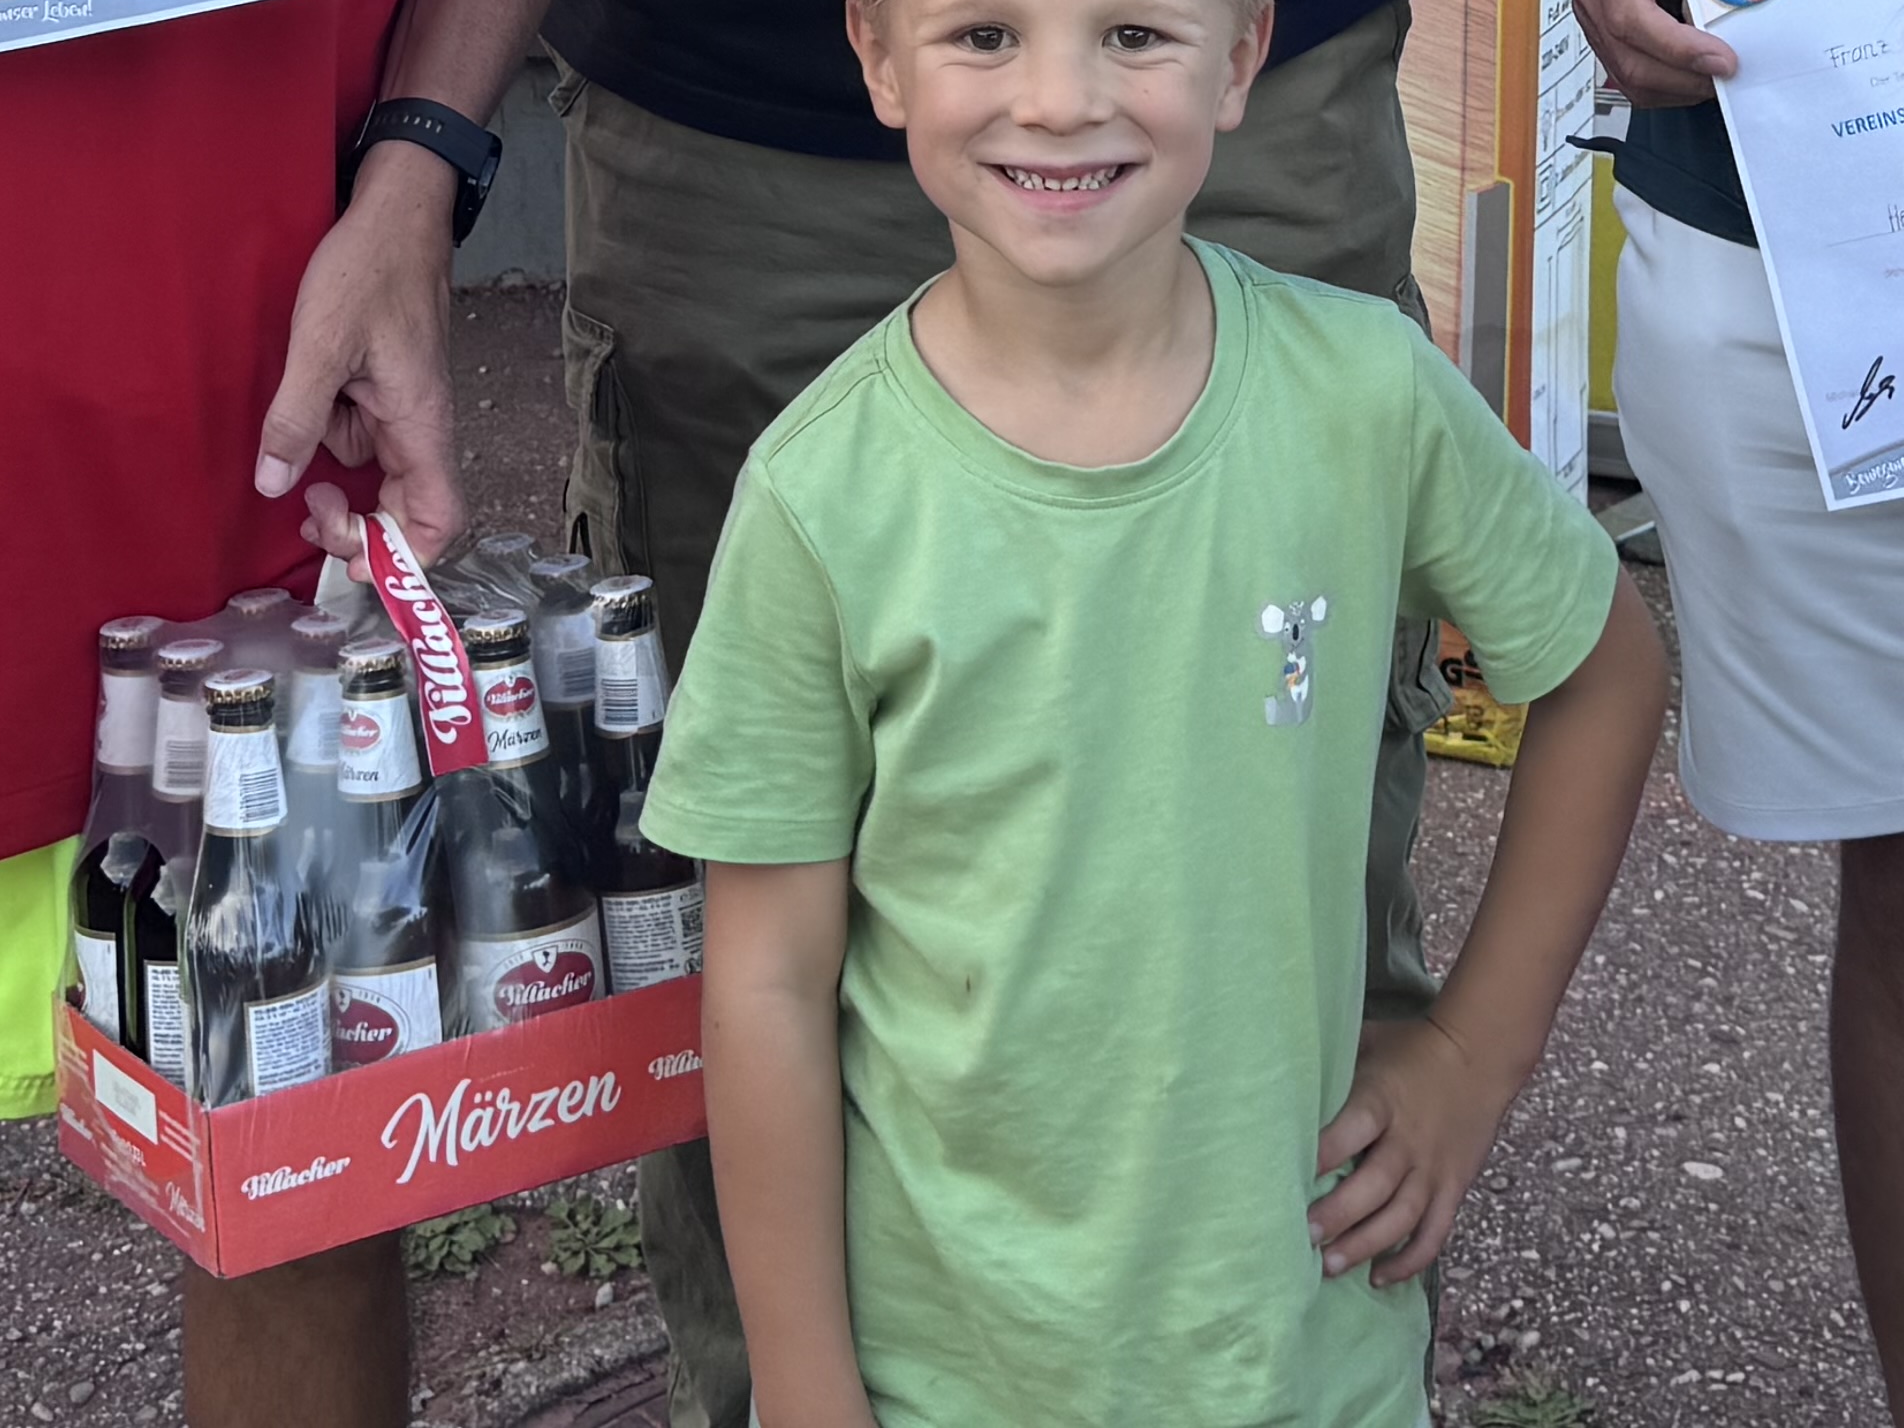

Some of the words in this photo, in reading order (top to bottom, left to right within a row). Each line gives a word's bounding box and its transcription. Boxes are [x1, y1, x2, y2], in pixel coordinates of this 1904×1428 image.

[498, 971, 592, 1006] Villacher
[381, 1070, 622, 1185] Märzen
[241, 1154, 352, 1201] Villacher
